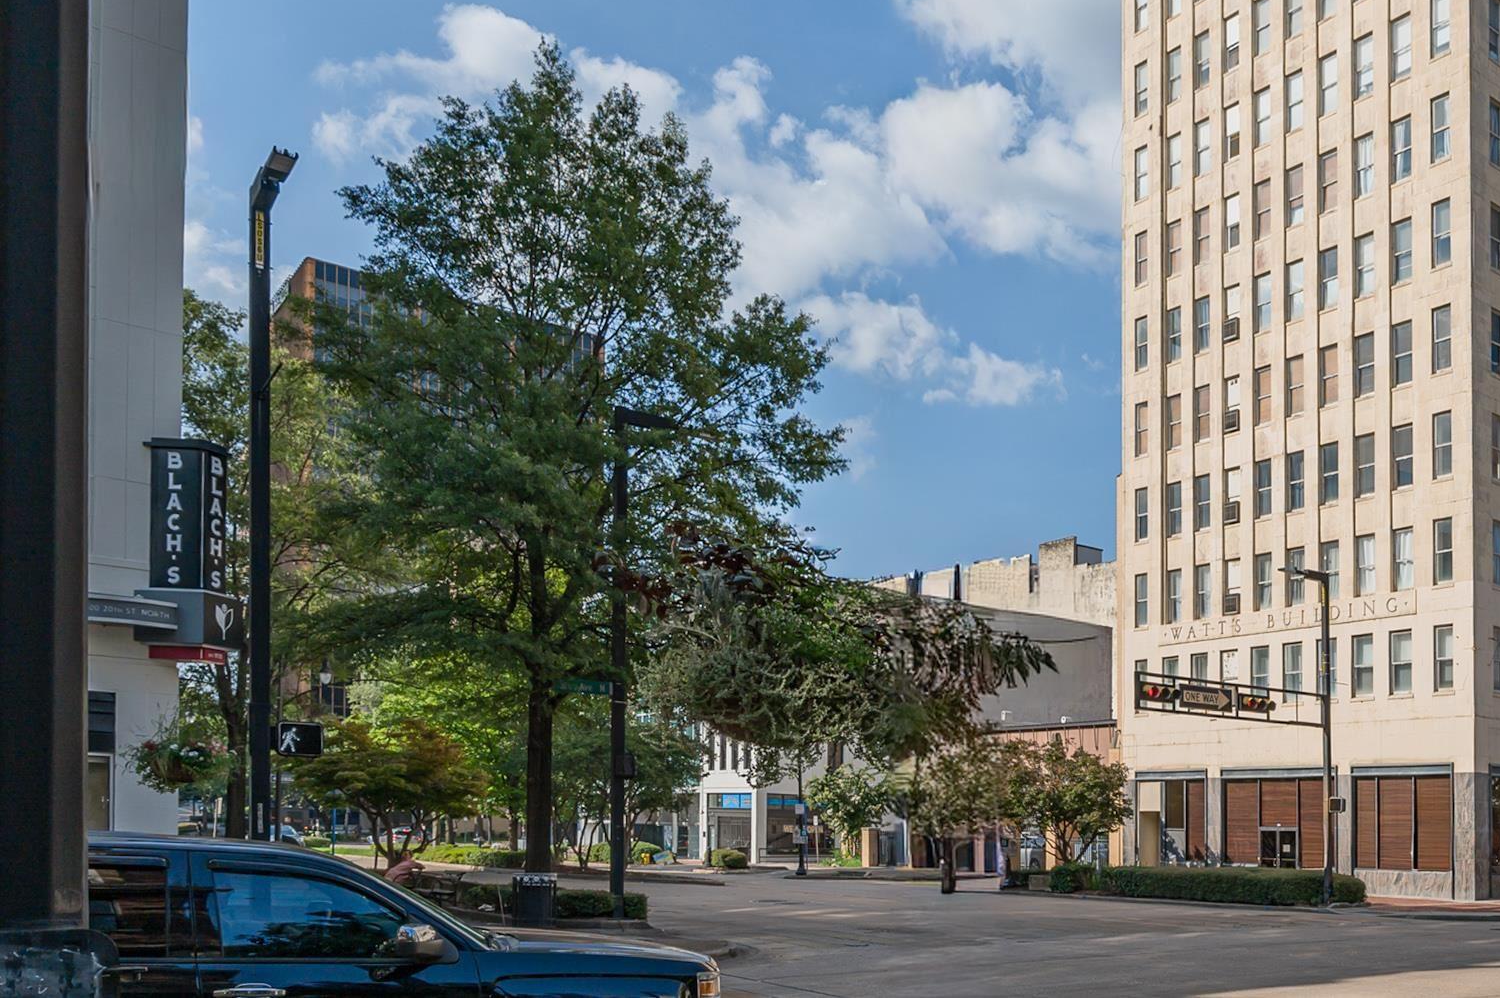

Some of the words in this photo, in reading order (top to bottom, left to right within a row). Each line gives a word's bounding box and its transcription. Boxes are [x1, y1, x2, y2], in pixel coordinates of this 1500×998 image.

[166, 452, 182, 584] BLACH'S
[209, 456, 224, 588] BLACH'S
[141, 609, 170, 619] NORTH
[1267, 597, 1398, 629] BUILDING
[1185, 691, 1201, 702] ONE
[1203, 693, 1218, 704] WAY
